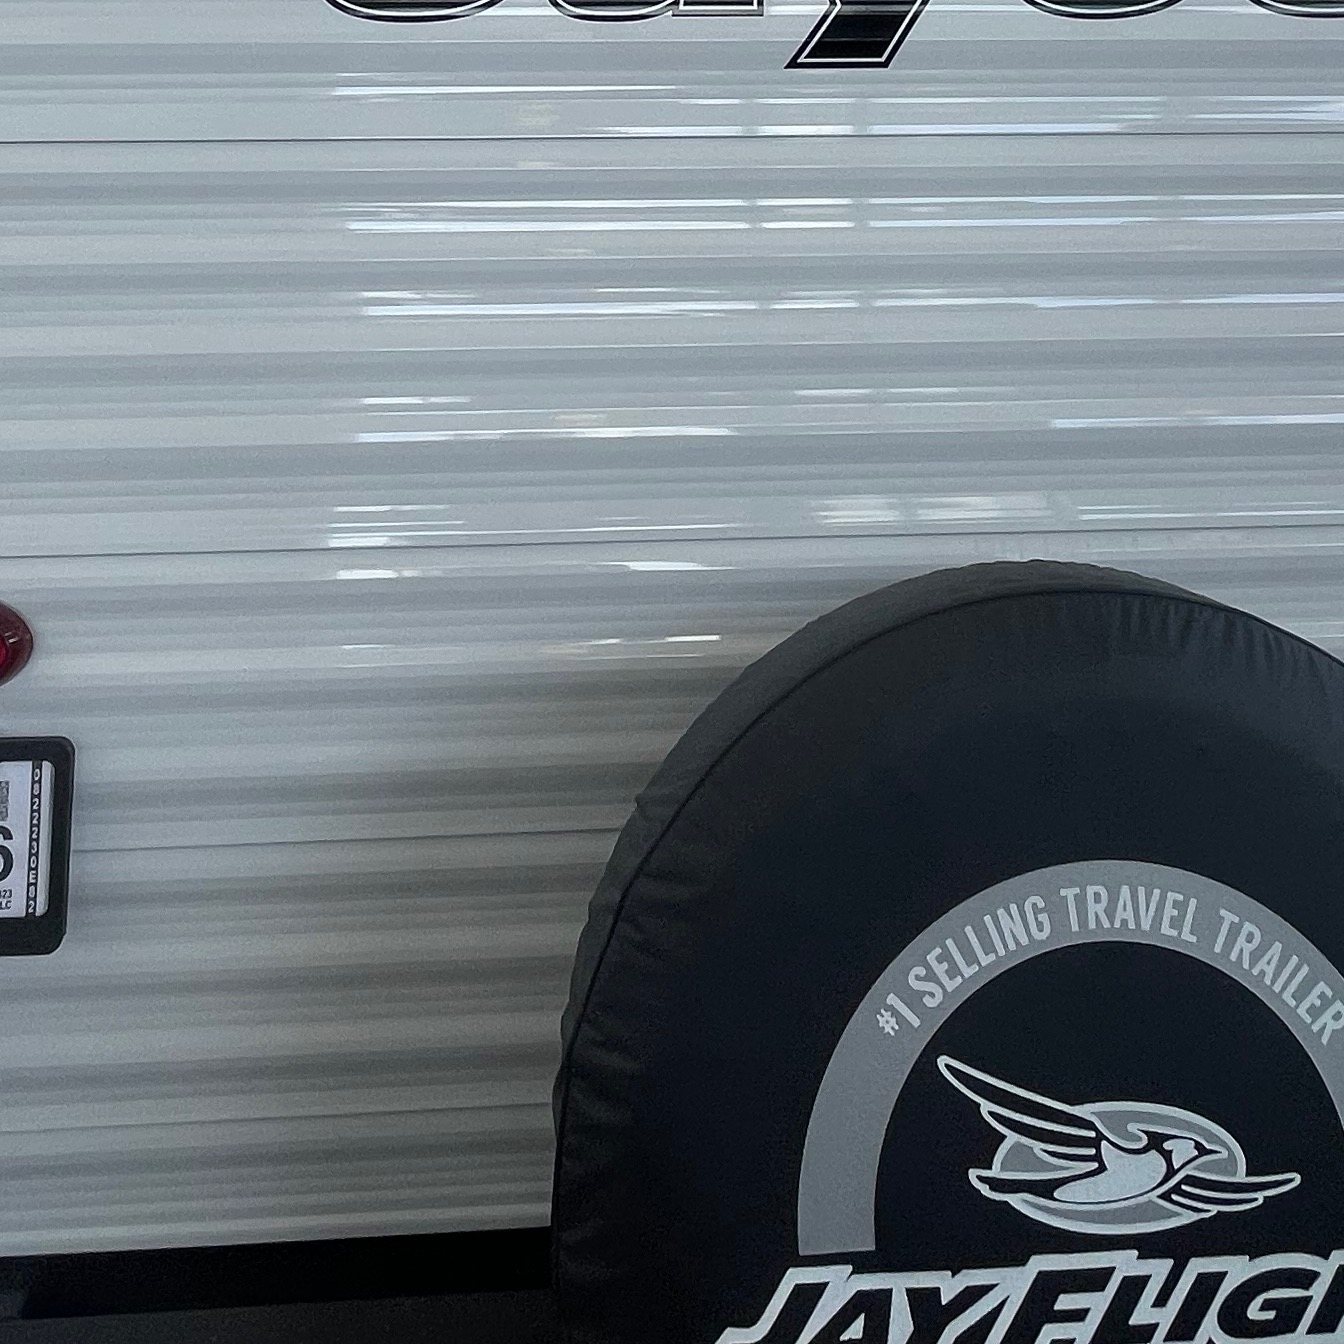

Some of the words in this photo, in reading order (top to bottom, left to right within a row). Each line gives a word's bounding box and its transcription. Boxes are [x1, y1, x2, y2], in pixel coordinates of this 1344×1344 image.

[875, 991, 922, 1037] #1
[907, 894, 1053, 1009] SELLING
[1059, 884, 1198, 944] TRAVEL
